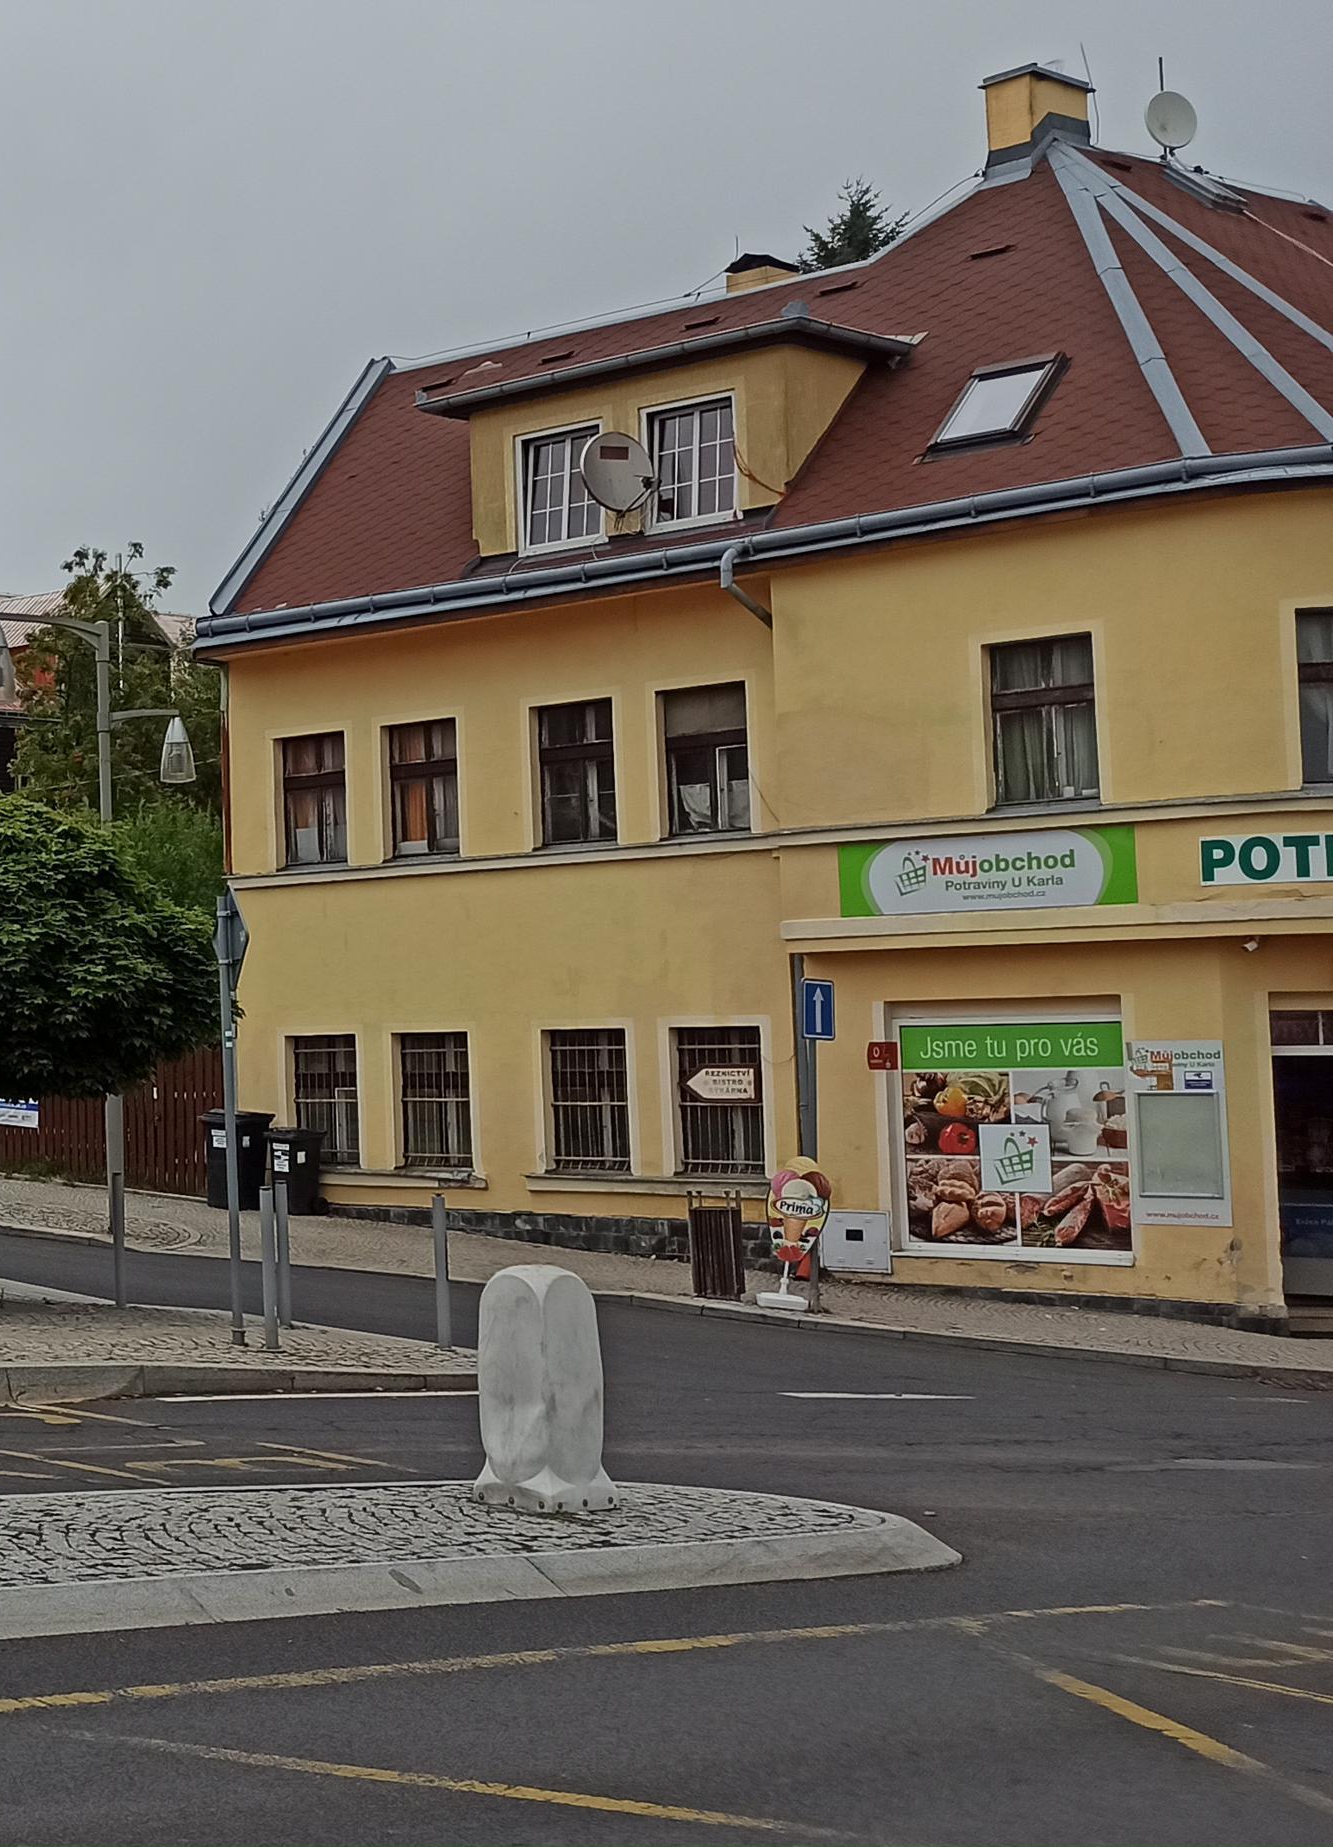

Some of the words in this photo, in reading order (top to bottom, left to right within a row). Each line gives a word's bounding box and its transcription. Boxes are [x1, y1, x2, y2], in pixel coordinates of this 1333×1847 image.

[932, 849, 1076, 878] Můjobchod
[1201, 834, 1333, 882] POT
[945, 879, 1007, 891] Potraviny
[1012, 877, 1022, 888] U
[1027, 875, 1064, 887] Karla
[919, 1036, 977, 1059] Jsme
[984, 1036, 1007, 1058] tu
[1016, 1037, 1052, 1062] pro
[1059, 1032, 1100, 1057] vás
[779, 1201, 814, 1215] Prima
